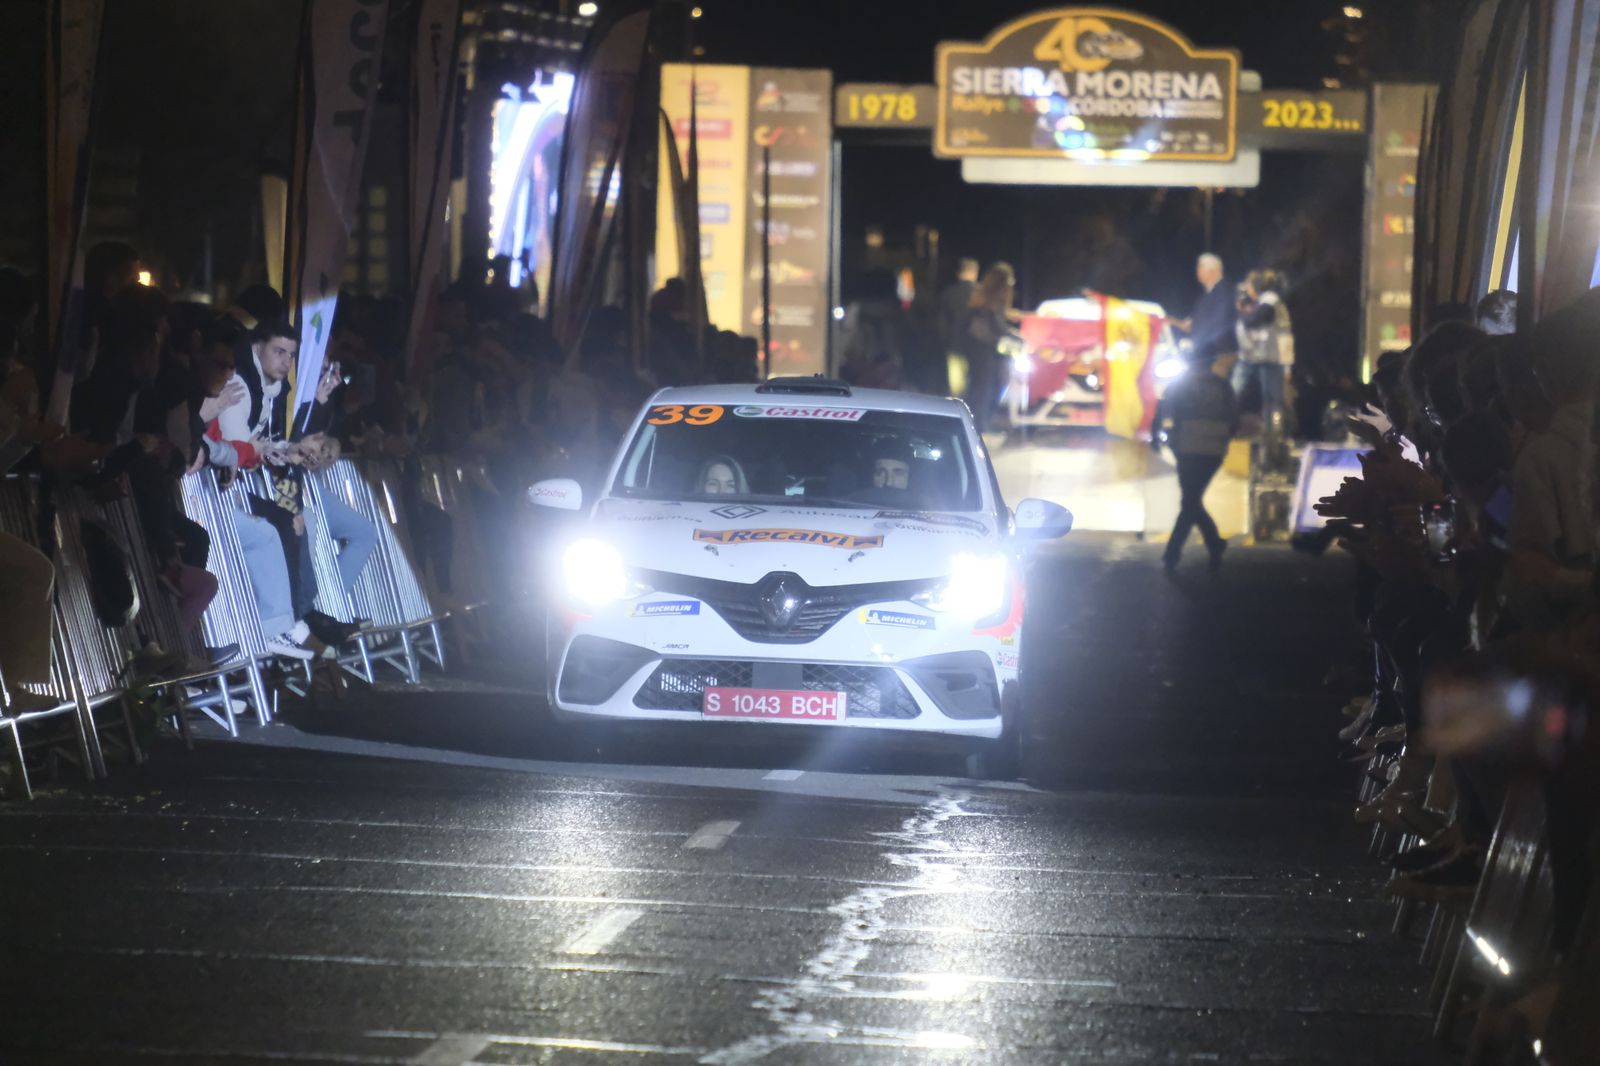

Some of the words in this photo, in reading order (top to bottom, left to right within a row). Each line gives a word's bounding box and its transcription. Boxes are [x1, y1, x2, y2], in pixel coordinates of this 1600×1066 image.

[952, 67, 1069, 97] SIERRA
[1076, 70, 1222, 99] MORENA
[849, 92, 917, 121] 1978
[648, 405, 725, 426] 39
[766, 405, 860, 421] Castrol
[728, 530, 849, 546] Recalvi
[646, 604, 692, 613] MICHELIN
[881, 615, 928, 627] MICHELIN
[707, 693, 721, 712] S
[731, 694, 781, 714] 1043
[791, 696, 837, 716] BCH
